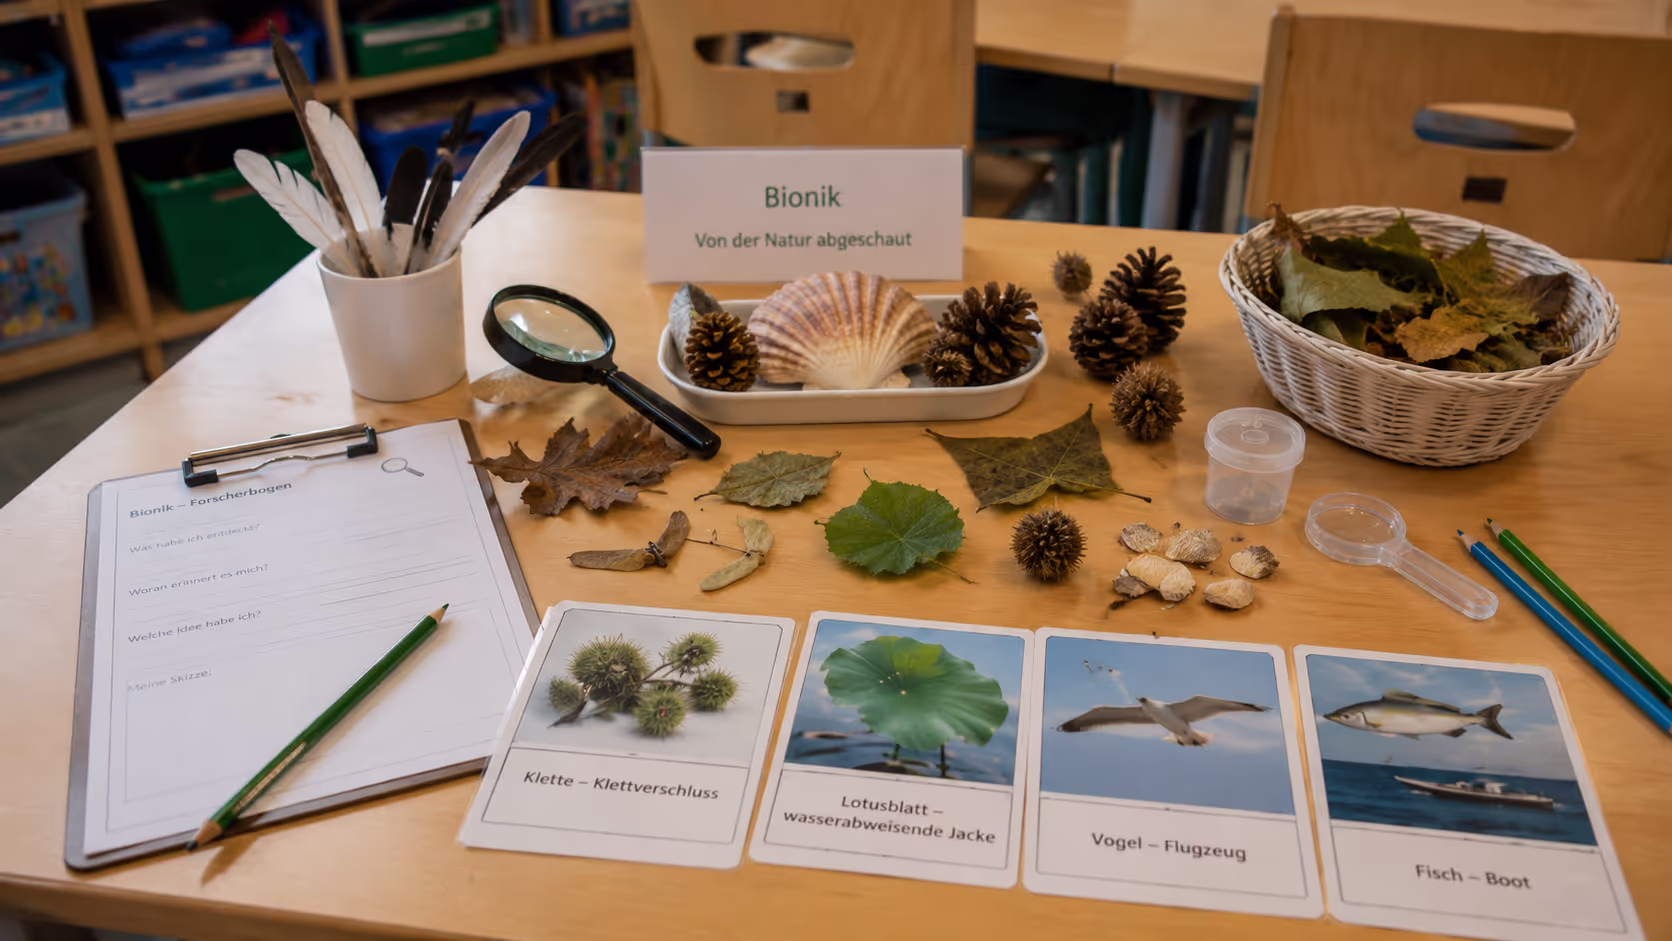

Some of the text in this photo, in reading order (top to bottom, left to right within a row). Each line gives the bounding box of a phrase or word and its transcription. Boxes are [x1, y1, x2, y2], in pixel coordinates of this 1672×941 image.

[764, 185, 841, 208] Bionik
[695, 231, 912, 250] Von der Natur abgeschaut
[129, 504, 174, 518] Bionik
[190, 483, 292, 507] Forscherbogen
[129, 544, 153, 553] Was
[156, 537, 184, 549] habe
[187, 534, 204, 543] ich
[128, 563, 269, 596] Woran erinnert es mich?
[128, 610, 262, 643] Welche Idee habe ich?
[170, 668, 212, 685] Skizze:
[523, 771, 574, 787] Klette
[593, 778, 719, 800] Klettverschluss
[841, 796, 929, 816] Lotusblatt
[783, 811, 996, 844] wasserabweisende Jacke
[1091, 832, 1142, 852] Vogel
[1164, 839, 1247, 863] Flugzeug
[1415, 864, 1463, 882] Fisch
[1485, 871, 1532, 889] Boot
